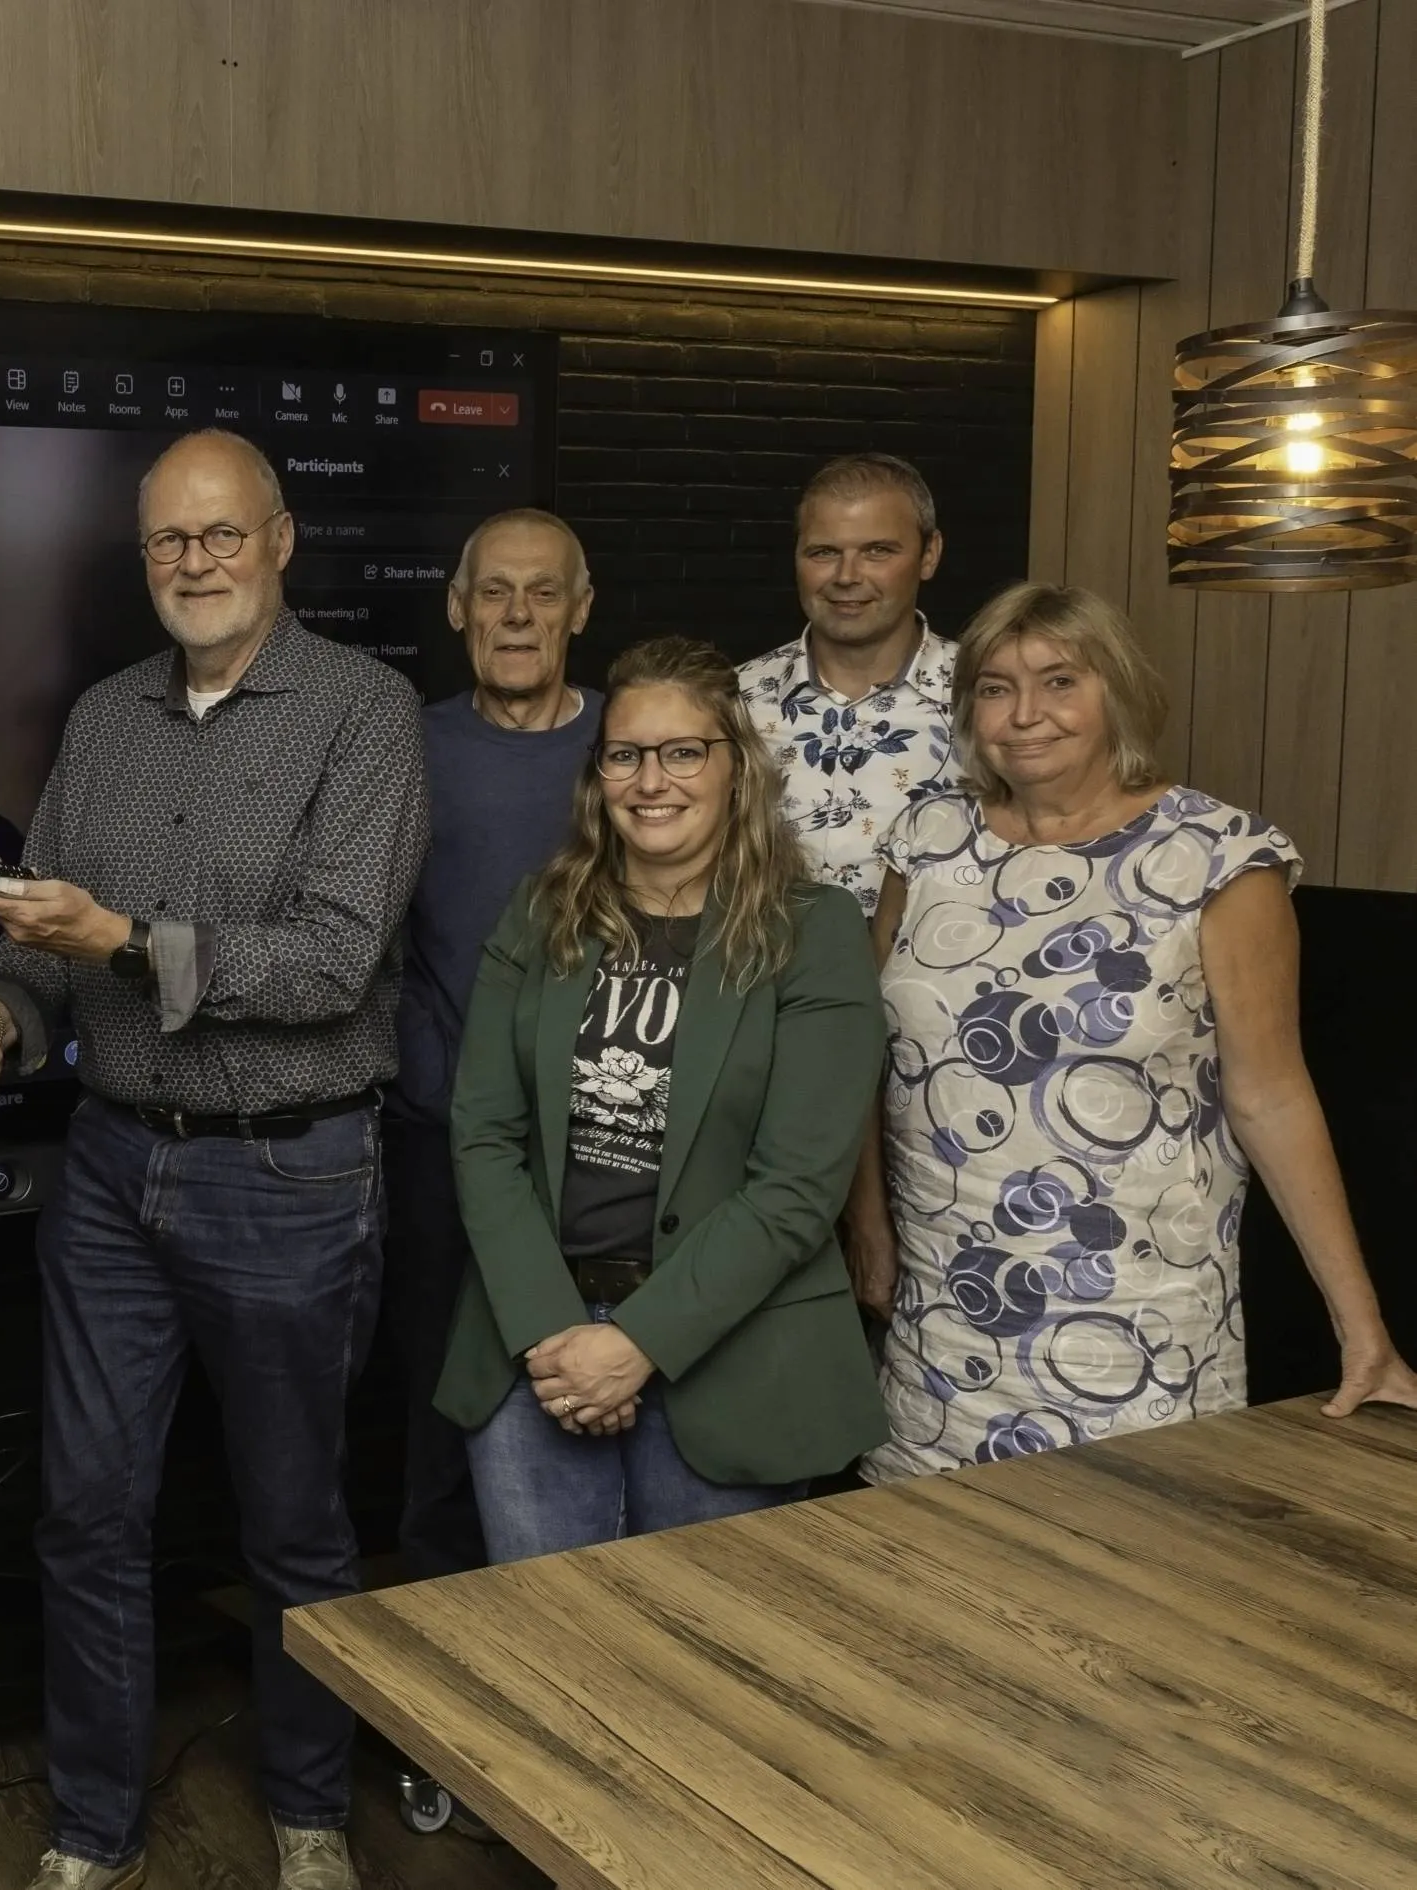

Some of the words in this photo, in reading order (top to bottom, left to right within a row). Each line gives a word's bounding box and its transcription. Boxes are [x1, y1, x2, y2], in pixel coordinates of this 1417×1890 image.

[6, 400, 30, 411] View
[57, 401, 86, 413] Notes
[109, 403, 141, 416] Rooms
[453, 404, 483, 416] Leave
[165, 406, 189, 419] Apps
[215, 408, 240, 419] More
[275, 410, 309, 422] Camera
[332, 412, 348, 423] Mic
[375, 415, 399, 425] Share
[287, 458, 364, 476] Participants
[299, 522, 323, 538] Type
[326, 526, 333, 536] a
[335, 526, 366, 536] name
[383, 566, 414, 579] Share
[416, 567, 446, 579] invite
[298, 608, 316, 618] this
[317, 608, 355, 621] meeting
[381, 644, 418, 656] Homan
